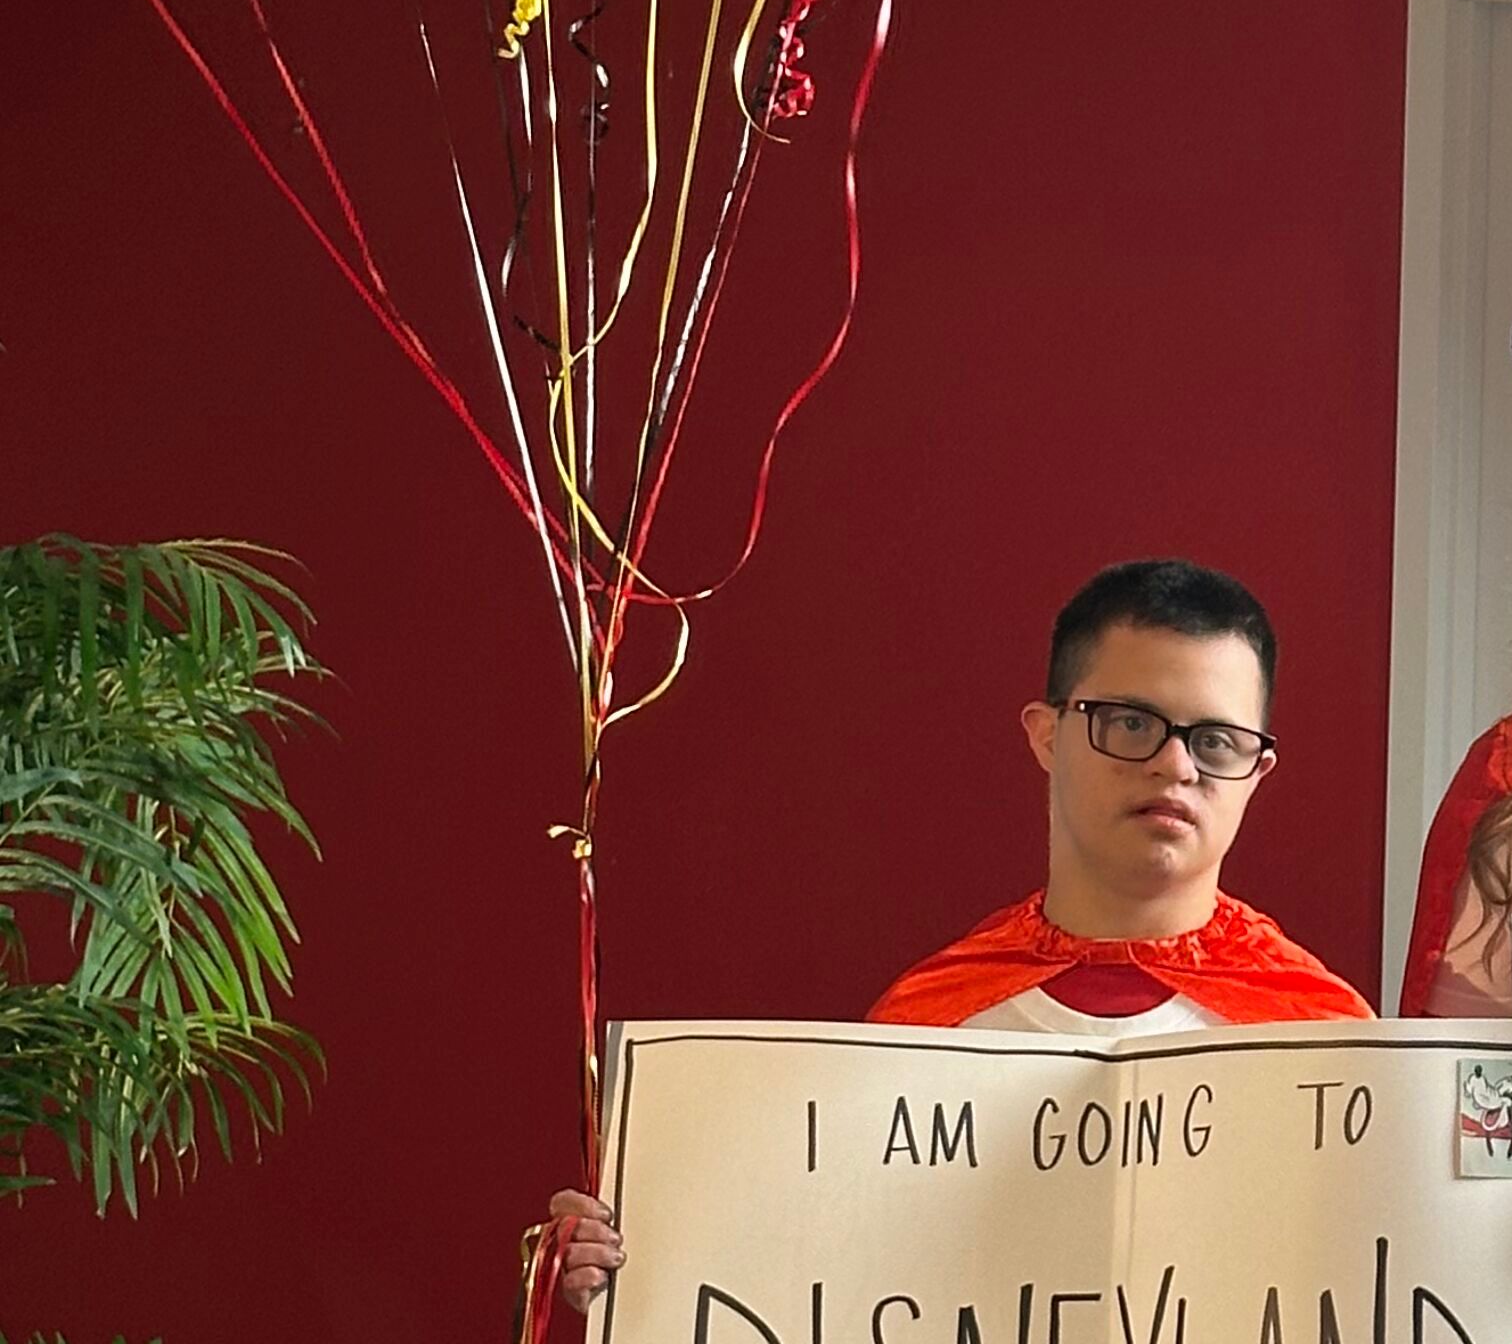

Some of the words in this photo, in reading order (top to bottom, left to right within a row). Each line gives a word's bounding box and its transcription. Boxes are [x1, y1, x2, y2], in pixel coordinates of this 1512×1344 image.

[807, 1100, 817, 1173] I
[882, 1095, 979, 1169] AM
[1032, 1084, 1213, 1172] GOING
[1296, 1081, 1373, 1151] TO
